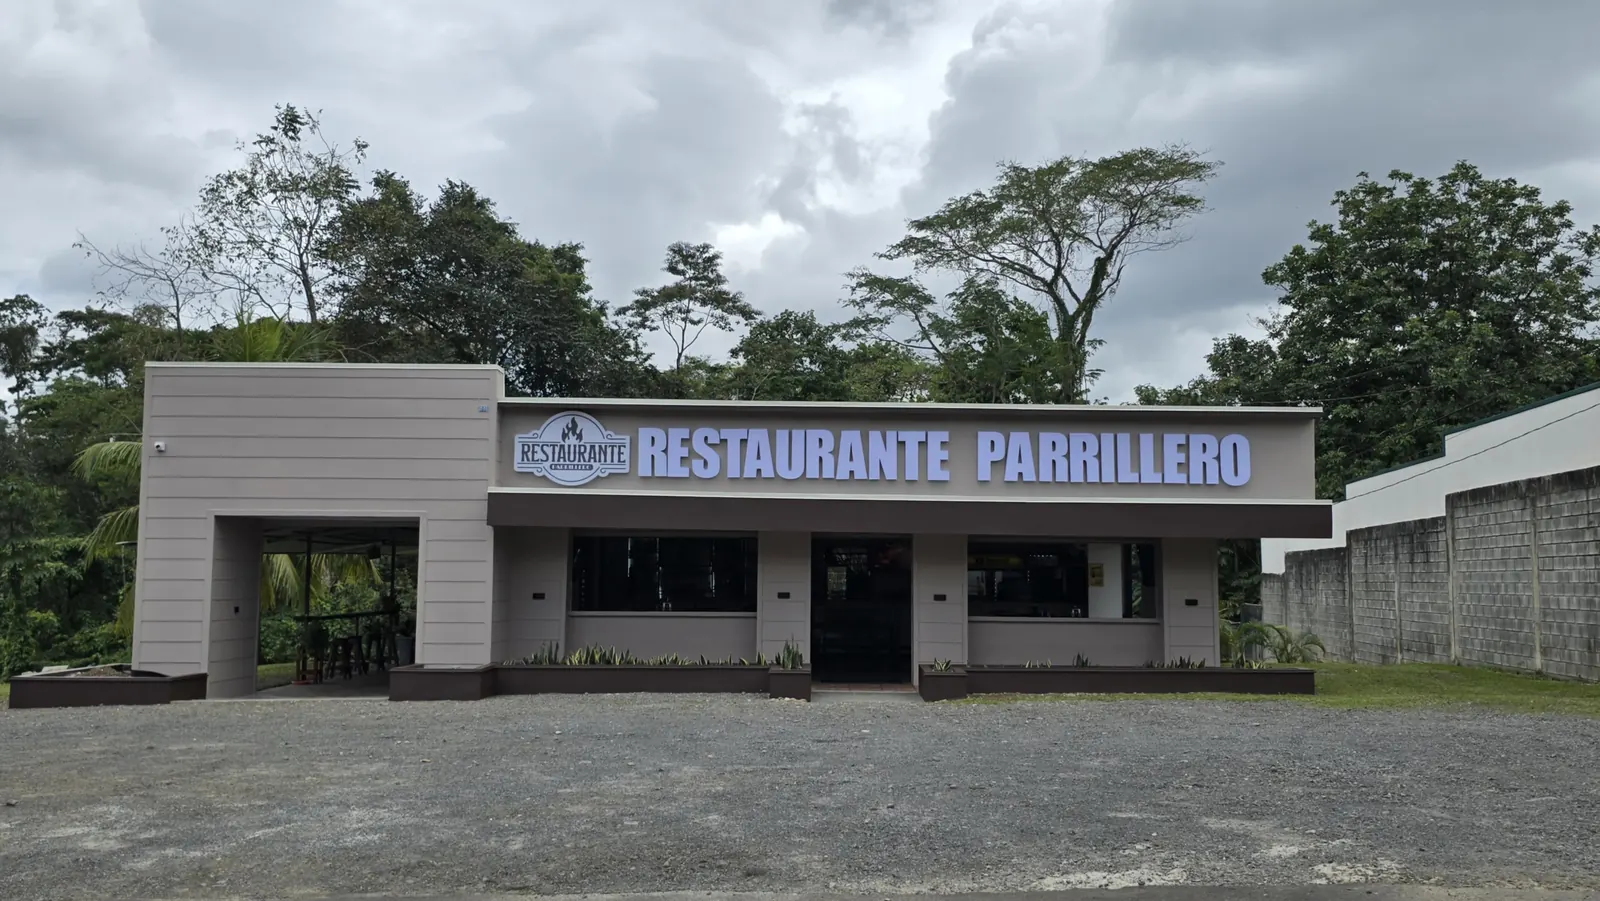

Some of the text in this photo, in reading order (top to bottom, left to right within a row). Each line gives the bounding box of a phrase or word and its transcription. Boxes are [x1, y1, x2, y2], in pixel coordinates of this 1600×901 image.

[521, 443, 626, 463] RESTAURANTE
[638, 427, 1251, 487] RESTAURANTE PARRILLERO
